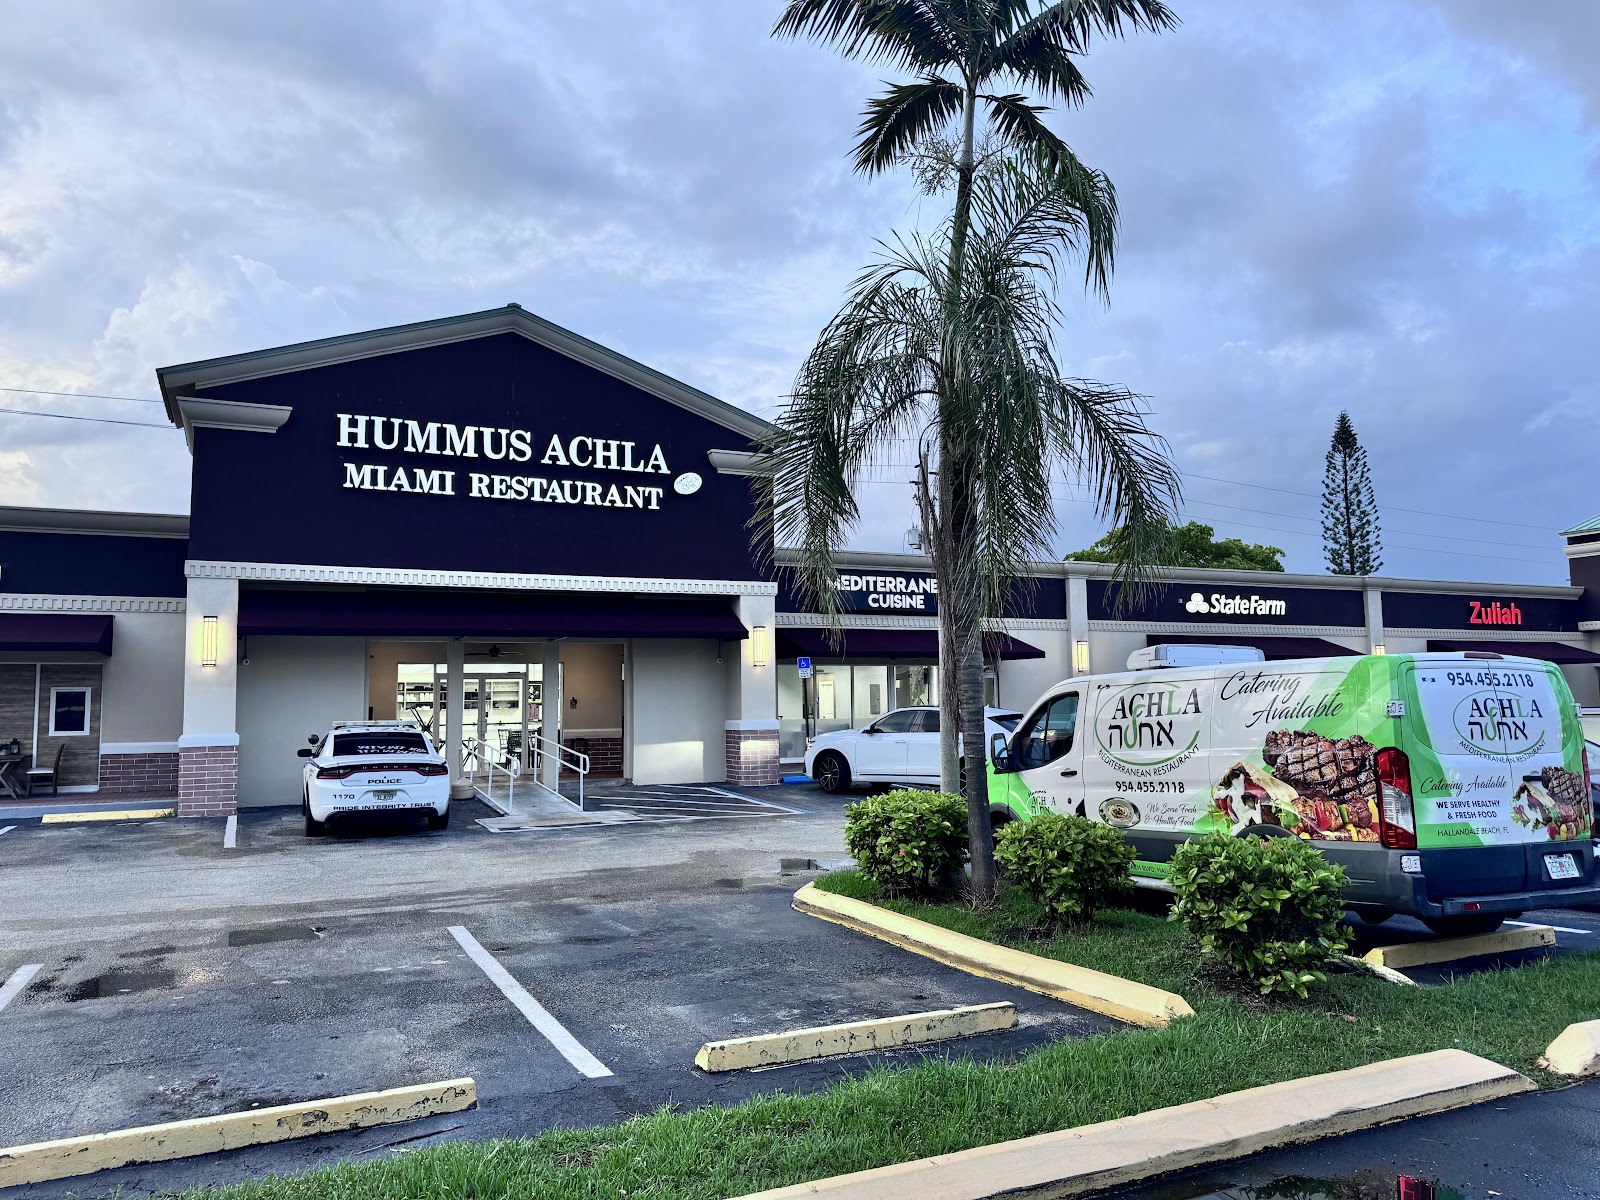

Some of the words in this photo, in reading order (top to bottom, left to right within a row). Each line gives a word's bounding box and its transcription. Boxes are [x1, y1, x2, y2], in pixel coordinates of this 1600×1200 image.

[336, 413, 532, 462] HUMMUS
[541, 433, 671, 474] ACHLA
[343, 463, 455, 496] MIAMI
[469, 473, 663, 510] RESTAURANT
[826, 574, 939, 594] MEDITERRANE
[868, 594, 925, 609] CUISINE
[1469, 601, 1522, 625] Zuliah
[1220, 671, 1302, 704] Catering
[1446, 672, 1534, 688] 954.455.2118
[1111, 687, 1202, 720] ACHLA
[1245, 693, 1344, 728] Available
[1469, 698, 1543, 718] ACHLA
[1098, 749, 1152, 778] MEDITERRANEAN
[1153, 744, 1200, 777] RESTAURANT
[1115, 781, 1185, 794] 954.455.2118
[1420, 777, 1464, 797] Catering
[1465, 775, 1507, 793] Available
[1436, 801, 1449, 809] WE
[1450, 800, 1471, 809] SERVE
[1472, 800, 1500, 808] HEALTHY
[1447, 812, 1454, 820] &
[1455, 811, 1476, 819] FRESH
[1478, 810, 1498, 818] FOOD
[1437, 827, 1480, 837] HALLANDALE
